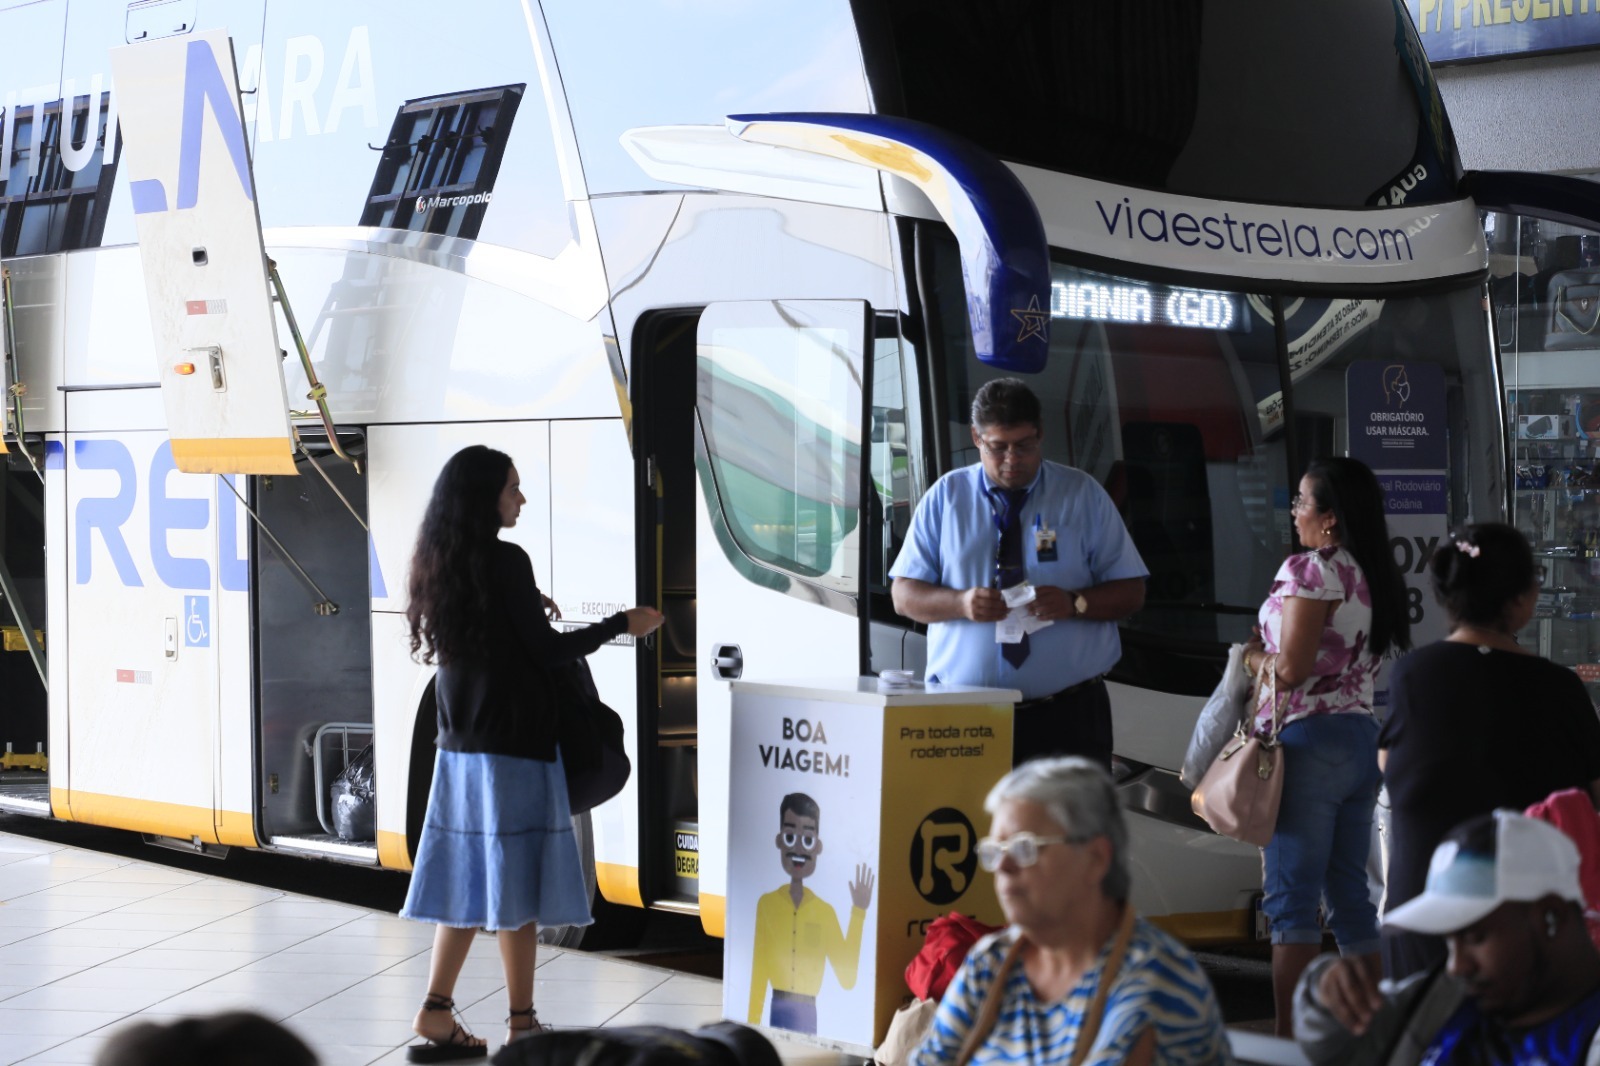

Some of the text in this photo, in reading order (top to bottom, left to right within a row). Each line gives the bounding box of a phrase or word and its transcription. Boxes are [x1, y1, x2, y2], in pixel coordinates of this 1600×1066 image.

[1453, 0, 1600, 30] PRESEN
[427, 191, 493, 208] Marcopolo
[1096, 197, 1414, 262] viaestrela.com
[1166, 291, 1234, 329] (GO)
[1370, 411, 1424, 422] OBRIGATÓRIO
[1366, 425, 1430, 436] USAR MÁSCARA.
[1395, 480, 1441, 492] Rodoviário
[1388, 498, 1423, 510] Goiânia
[782, 717, 828, 745] BOA
[900, 725, 996, 740] Pra toda rota,
[910, 743, 984, 760] roderotas!
[758, 744, 851, 778] VIAGEM!
[677, 834, 699, 851] CUIDA
[676, 856, 699, 874] DEGR
